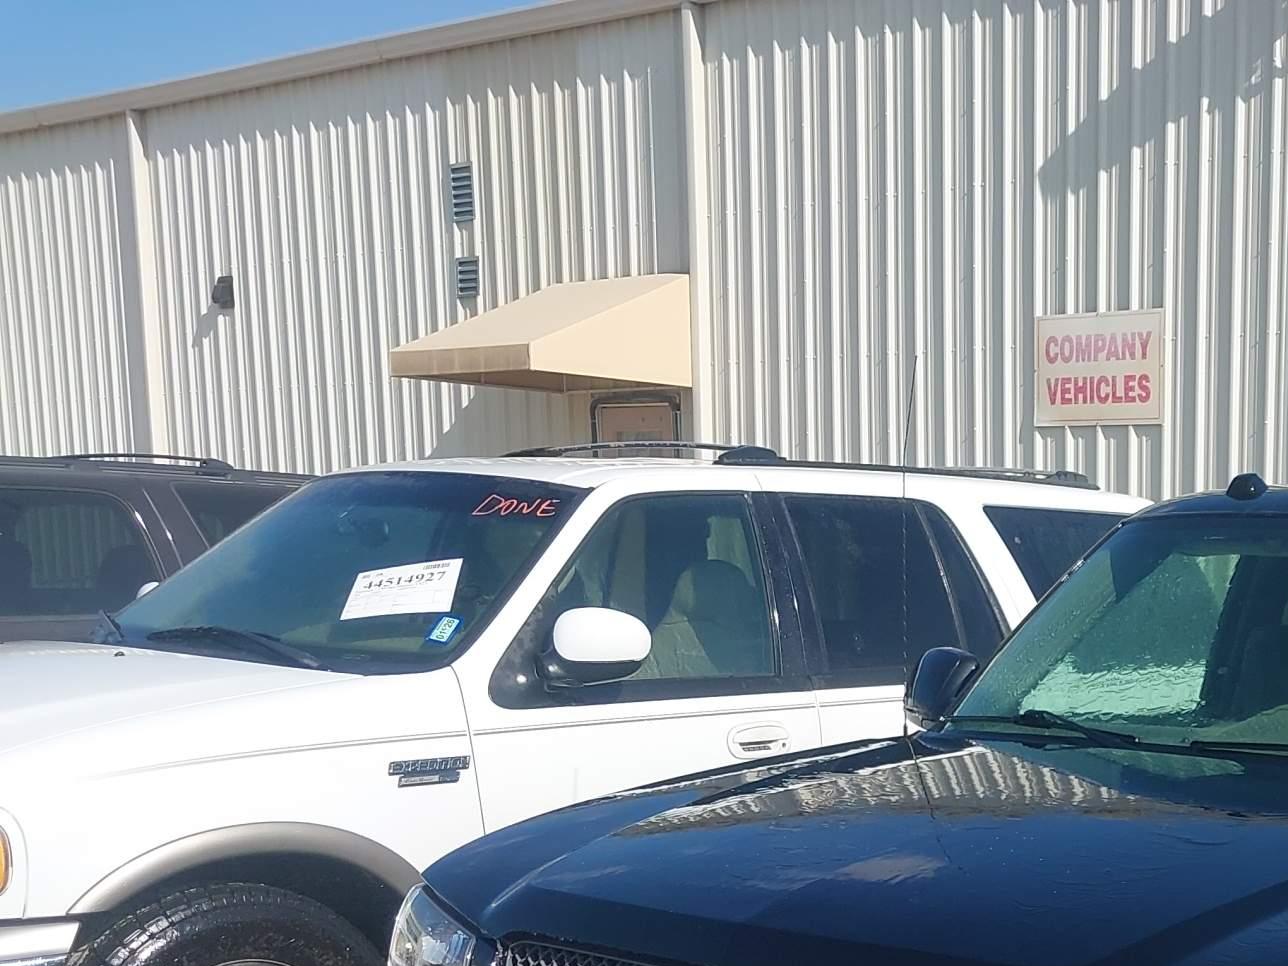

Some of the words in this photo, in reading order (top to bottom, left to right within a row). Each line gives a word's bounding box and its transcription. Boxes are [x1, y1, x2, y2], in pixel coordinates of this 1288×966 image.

[1045, 331, 1152, 364] COMPANY
[1046, 373, 1152, 406] VEHICLES
[472, 494, 560, 517] DONE
[363, 571, 447, 590] 44514927
